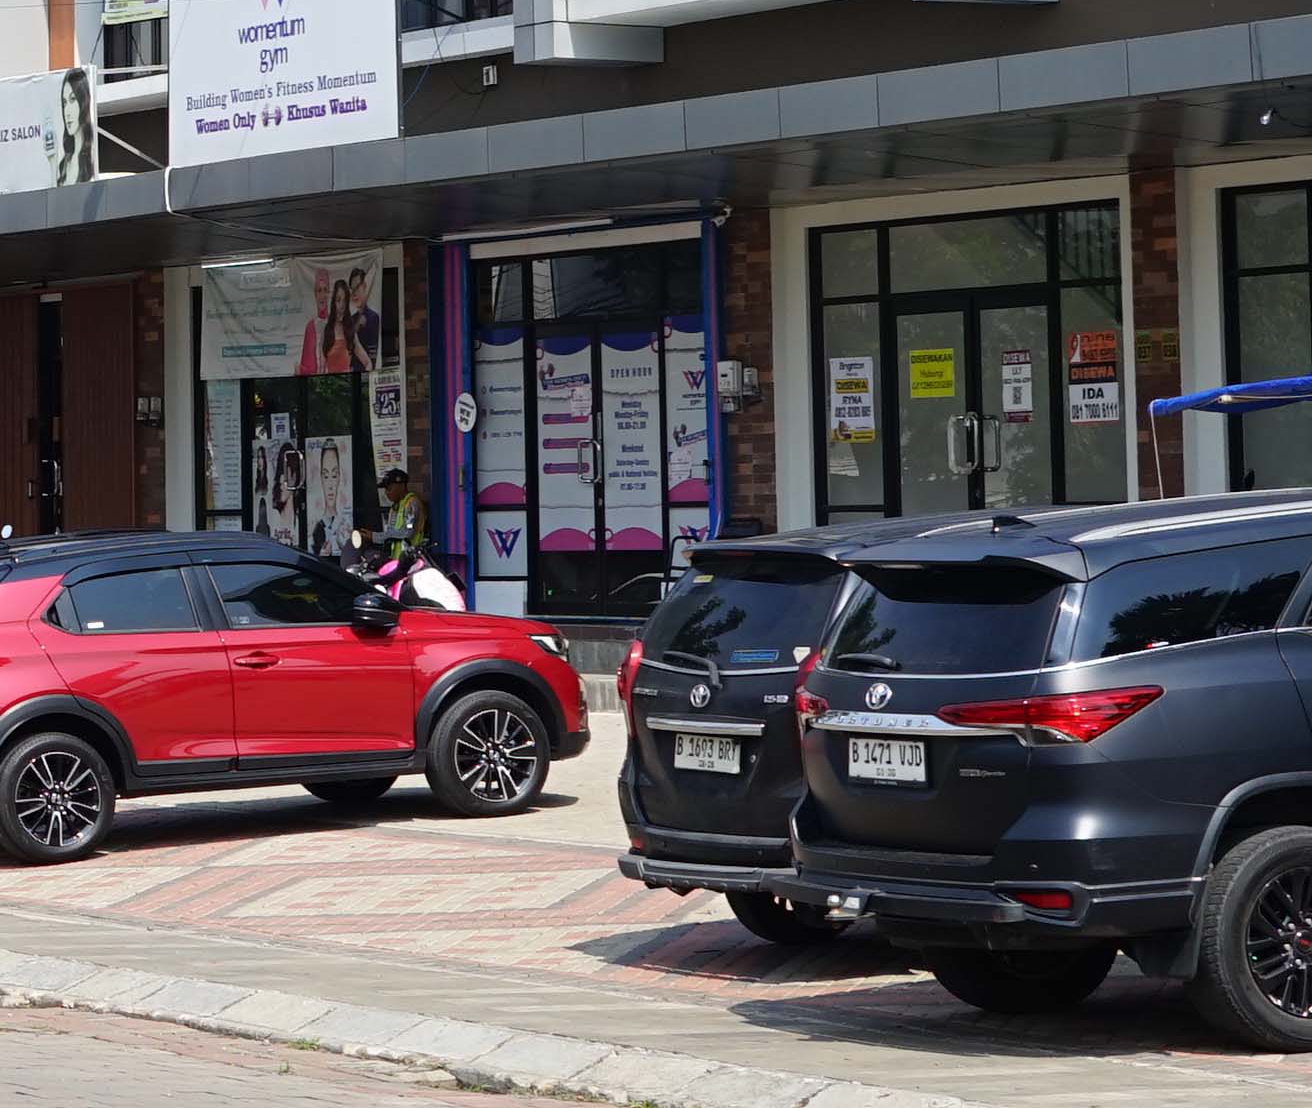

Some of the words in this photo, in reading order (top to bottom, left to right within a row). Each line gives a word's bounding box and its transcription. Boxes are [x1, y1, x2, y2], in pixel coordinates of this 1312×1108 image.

[238, 17, 305, 44] womentum
[259, 46, 288, 73] gym
[186, 93, 227, 111] Building
[230, 85, 273, 104] Women's
[276, 78, 314, 98] Fitness
[317, 70, 376, 90] Momentum
[196, 118, 230, 135] Women
[233, 111, 256, 130] Only
[287, 102, 326, 122] Khusus
[329, 96, 367, 115] Wanita
[11, 124, 41, 141] SALON
[610, 368, 630, 379] OPEN
[632, 367, 652, 377] HOUR
[1070, 366, 1115, 380] DISEWA
[1082, 387, 1104, 400] IDA
[676, 736, 684, 756] B
[688, 736, 714, 758] 1693
[718, 741, 741, 762] BRY
[852, 742, 860, 763] B
[864, 742, 892, 765] 1471
[899, 744, 923, 767] VJD
